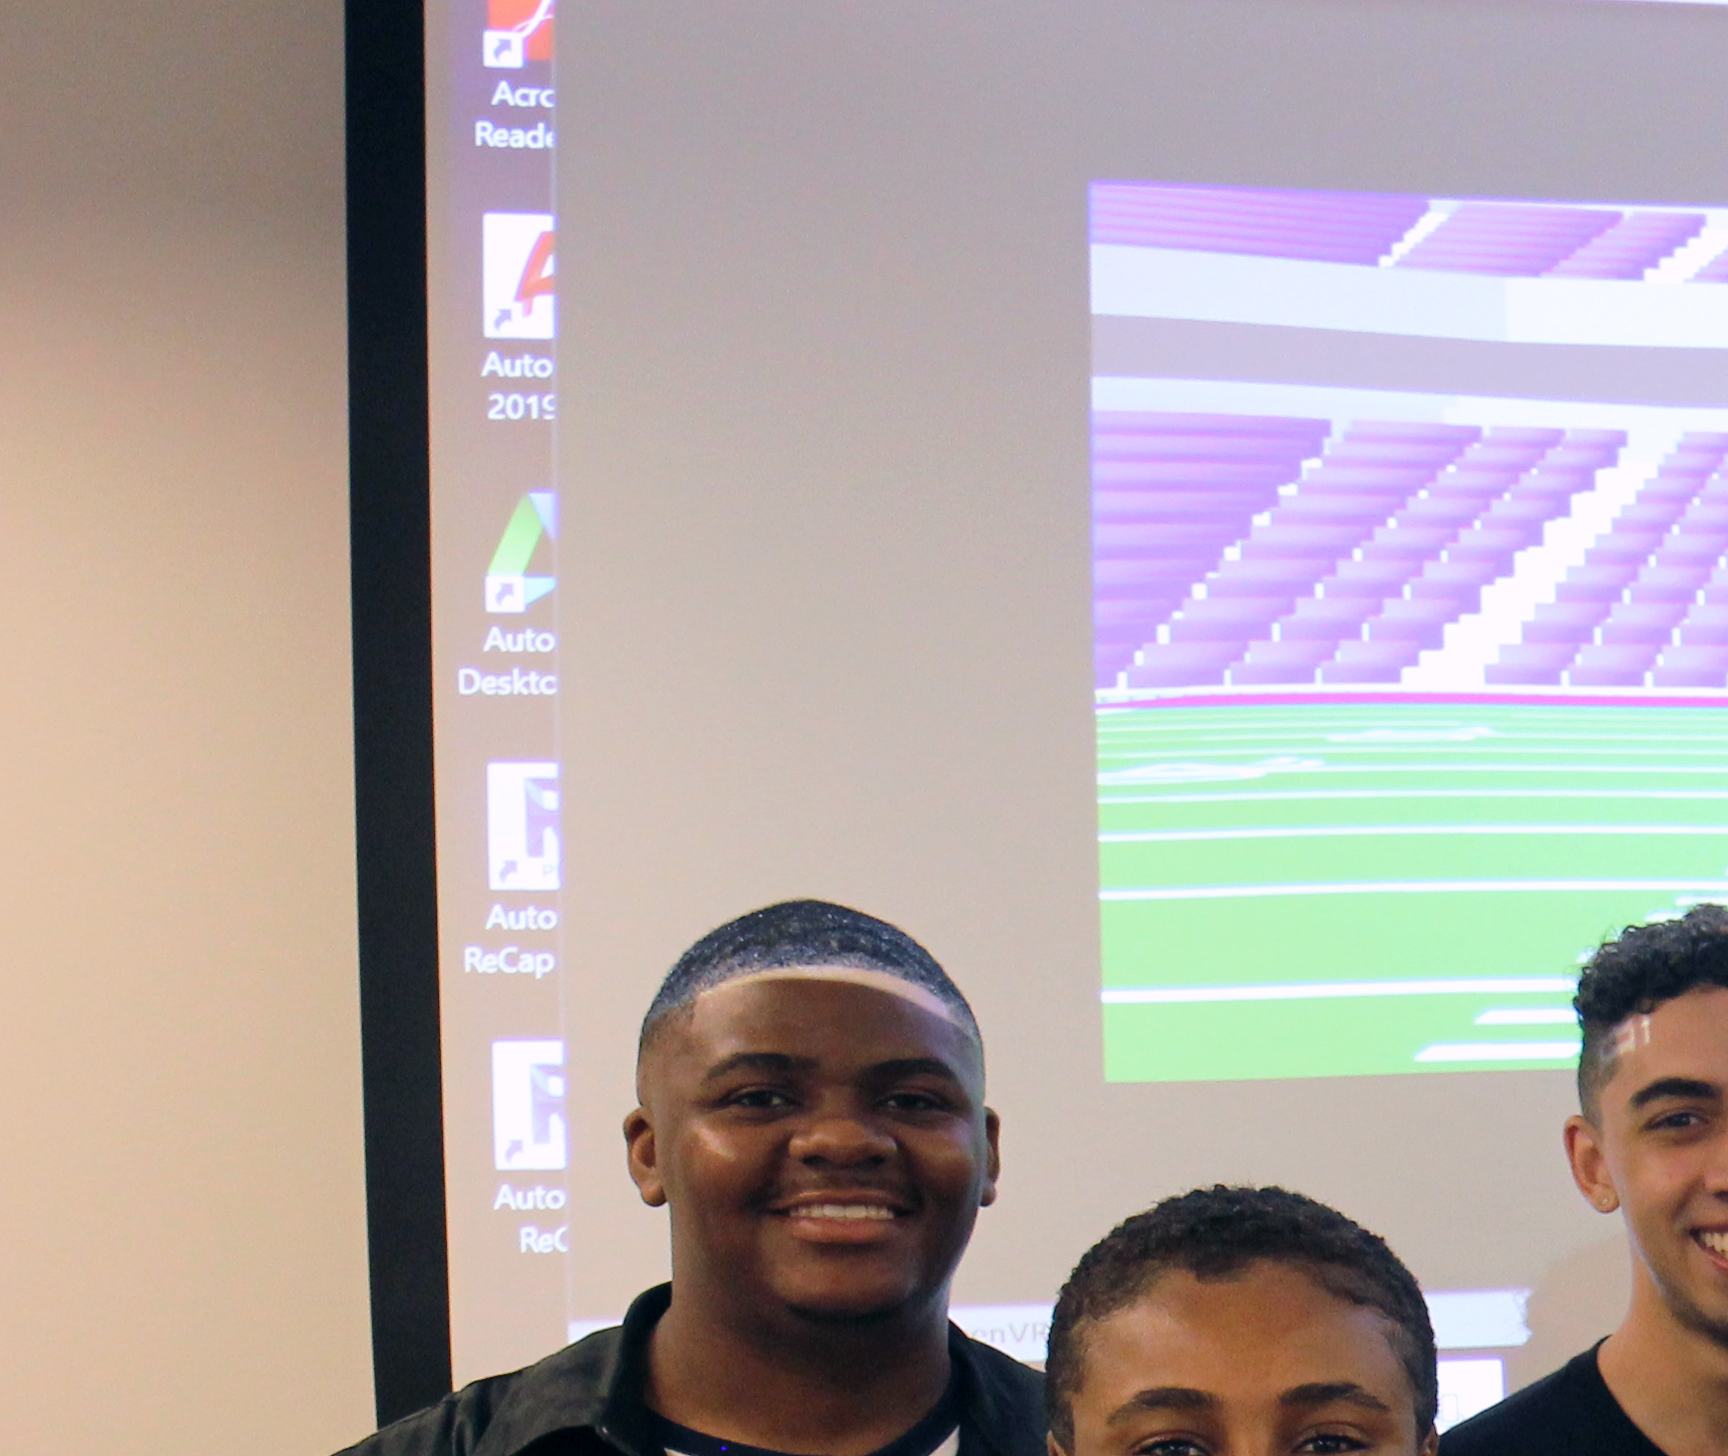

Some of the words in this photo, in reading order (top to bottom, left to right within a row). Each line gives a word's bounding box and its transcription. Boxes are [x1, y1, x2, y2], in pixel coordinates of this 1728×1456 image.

[481, 351, 554, 379] Auto
[483, 626, 557, 653] Auto
[485, 904, 558, 931] Auto
[463, 946, 556, 979] ReCap
[493, 1184, 566, 1211] Auto
